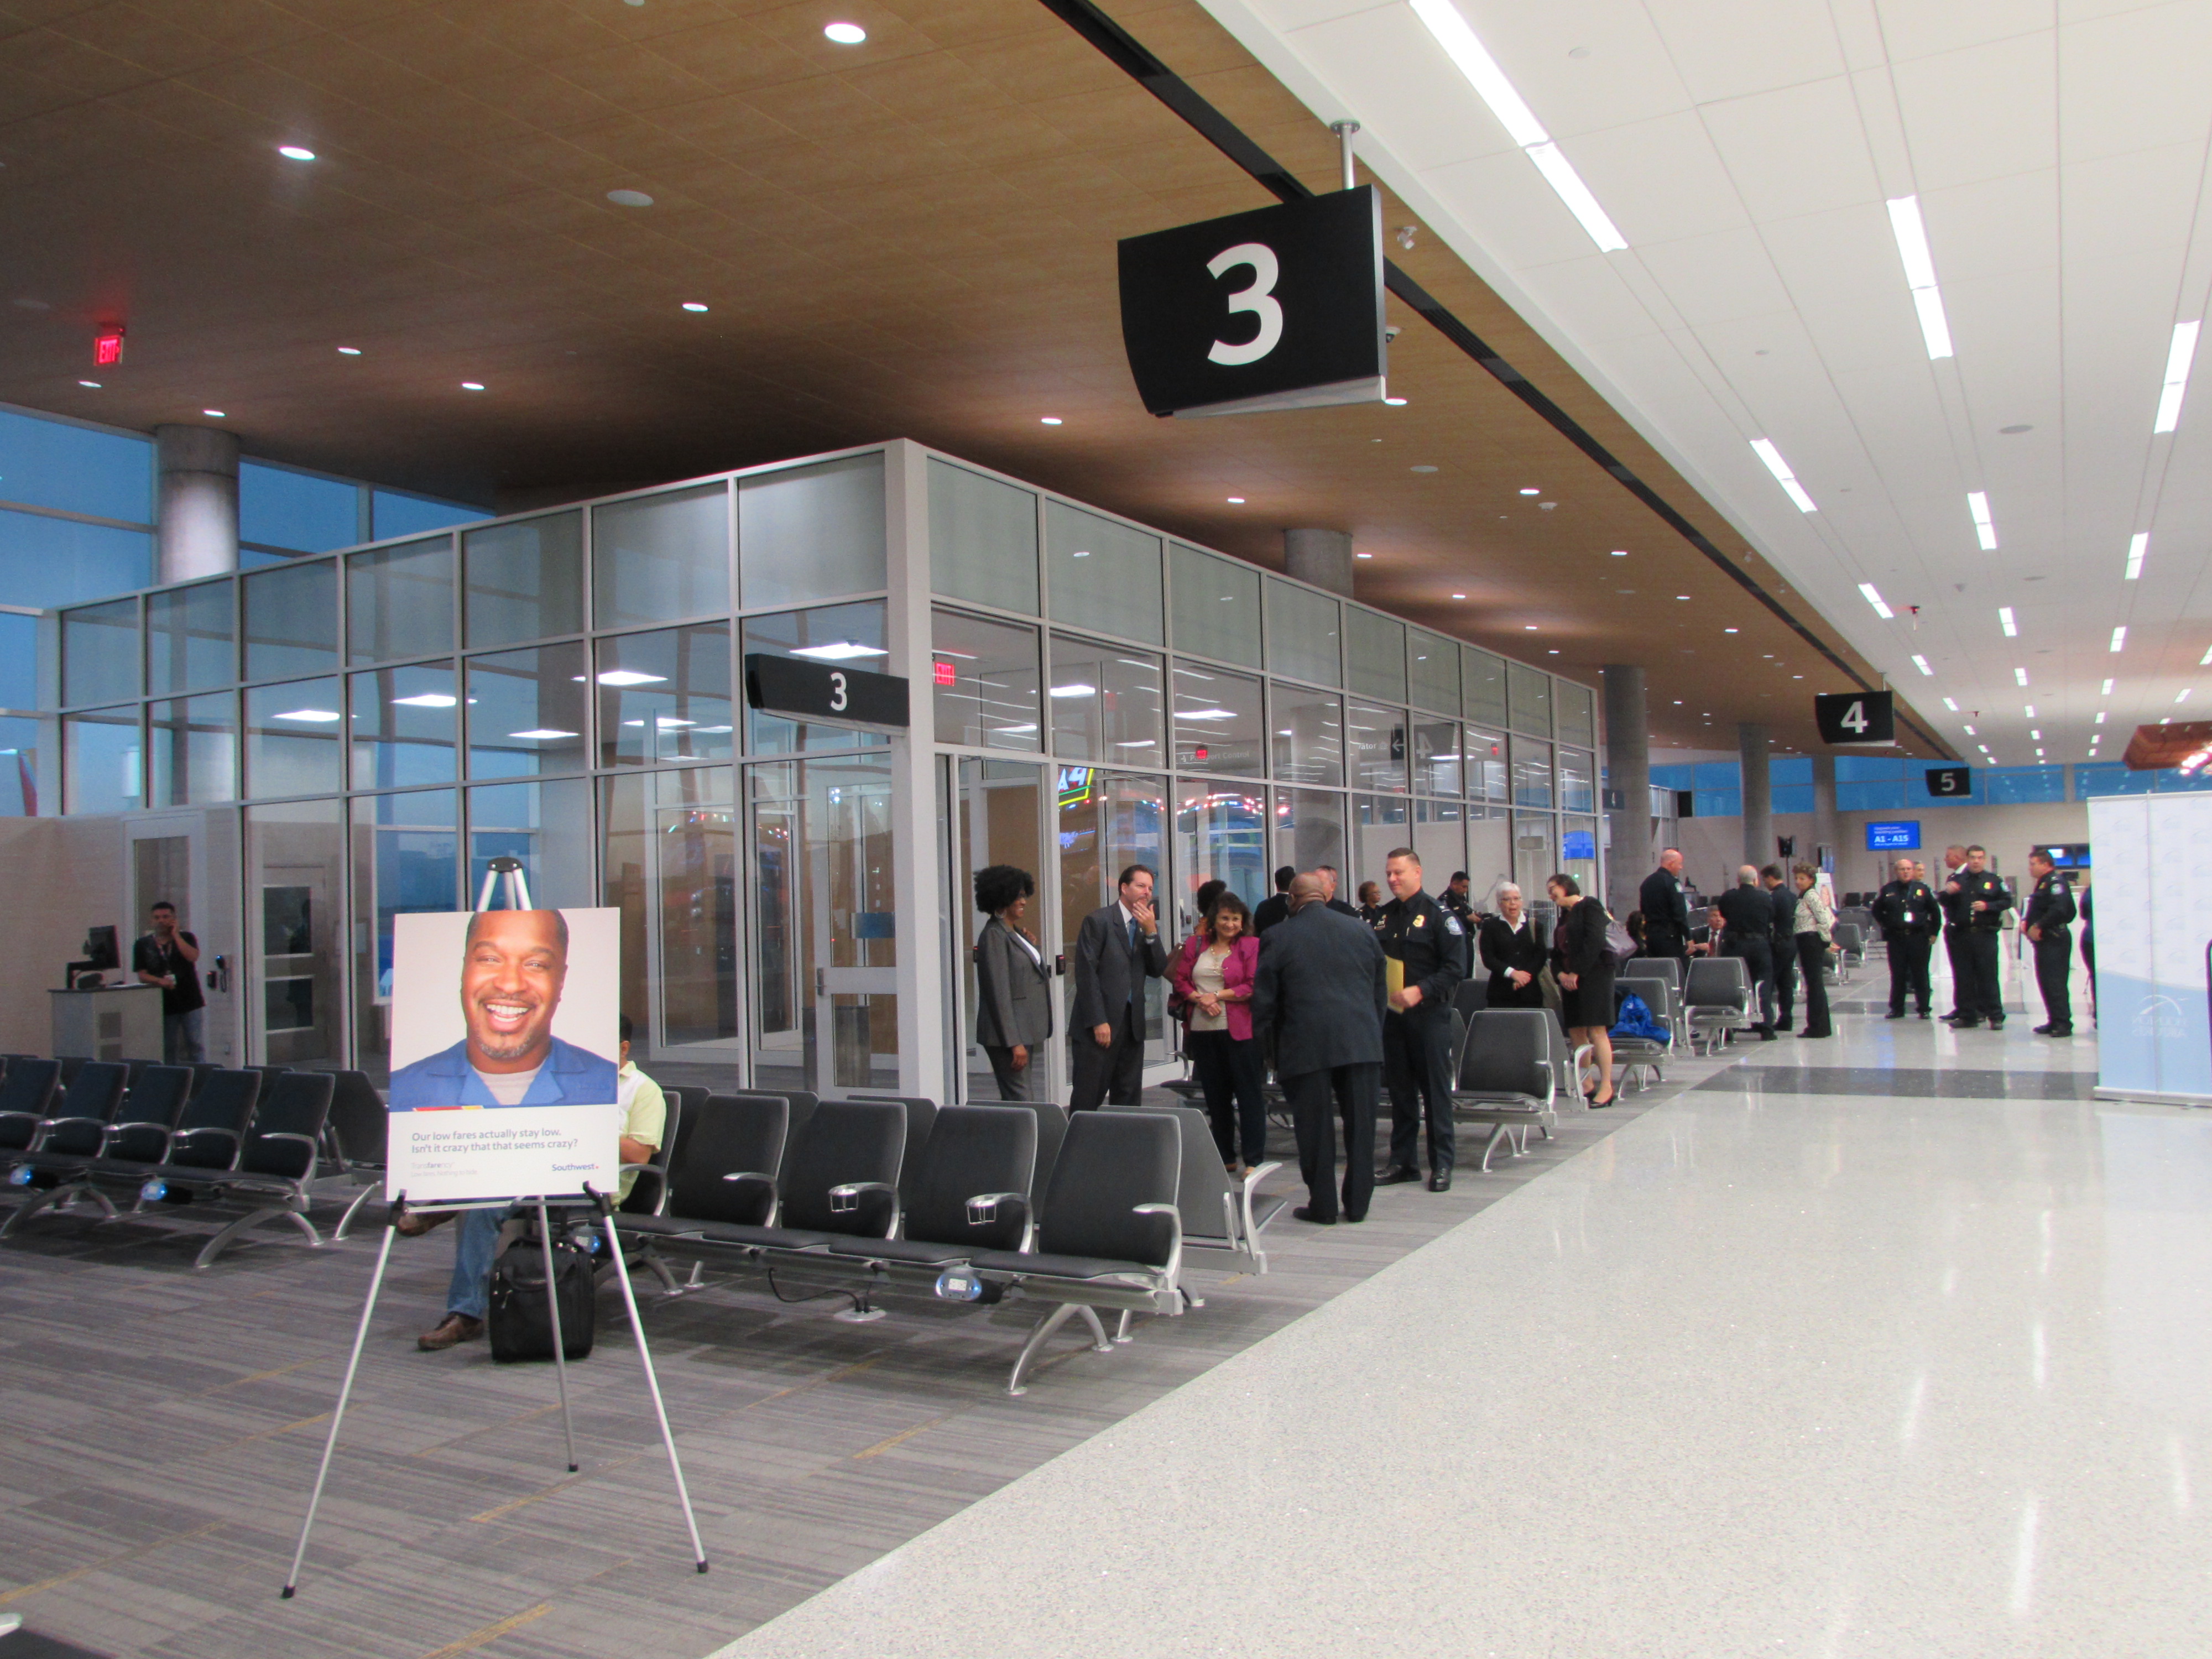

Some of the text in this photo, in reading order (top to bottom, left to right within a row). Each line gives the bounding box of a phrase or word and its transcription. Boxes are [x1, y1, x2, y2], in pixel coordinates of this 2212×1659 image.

[1206, 242, 1284, 366] 3
[100, 338, 117, 363] EXIT
[936, 662, 952, 685] EXIT
[830, 672, 848, 711] 3
[1840, 701, 1869, 733] 4
[1941, 773, 1956, 792] 5
[412, 1128, 561, 1141] Our low fares actually stay low.
[412, 1145, 432, 1153] Isn't
[434, 1144, 441, 1152] it
[442, 1145, 468, 1153] crazy
[471, 1142, 490, 1151] that
[493, 1141, 512, 1150] that
[547, 1139, 578, 1149] crazy?
